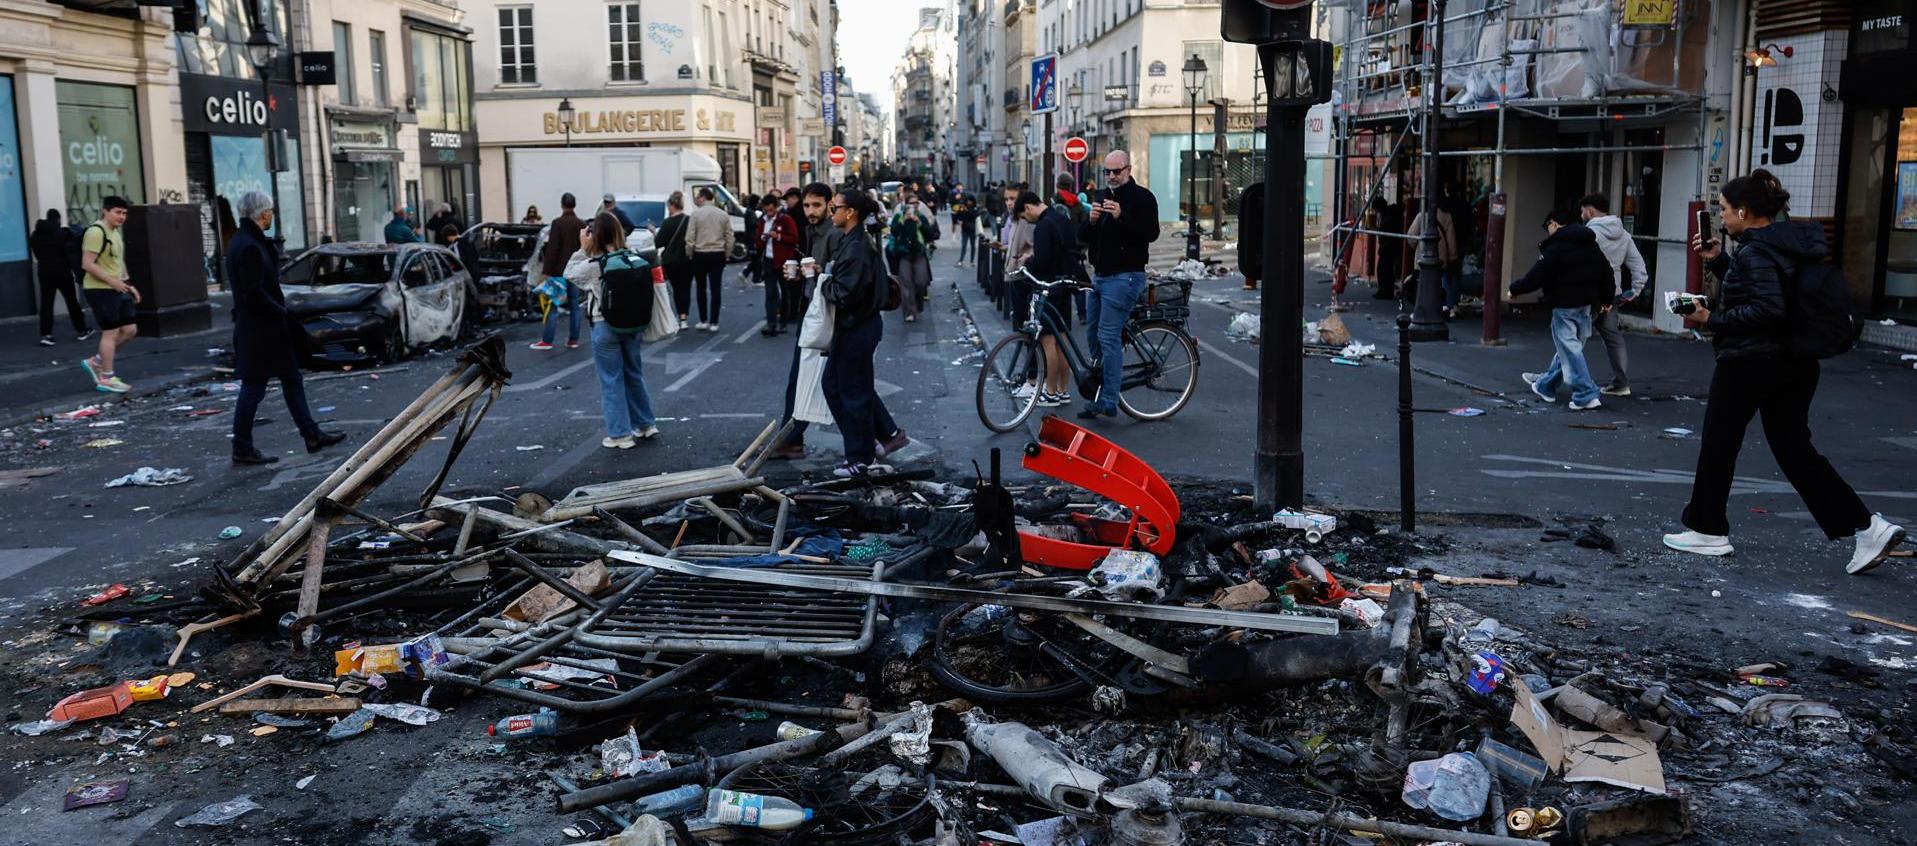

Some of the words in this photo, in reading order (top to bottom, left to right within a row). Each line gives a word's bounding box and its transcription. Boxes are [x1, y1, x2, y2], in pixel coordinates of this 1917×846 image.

[1862, 20, 1874, 31] MY
[1876, 15, 1902, 29] TASTE
[205, 90, 267, 125] celio
[543, 109, 686, 135] BOULANGERIE
[696, 108, 710, 131] &
[1309, 118, 1323, 132] PIZZA
[68, 136, 124, 165] celio
